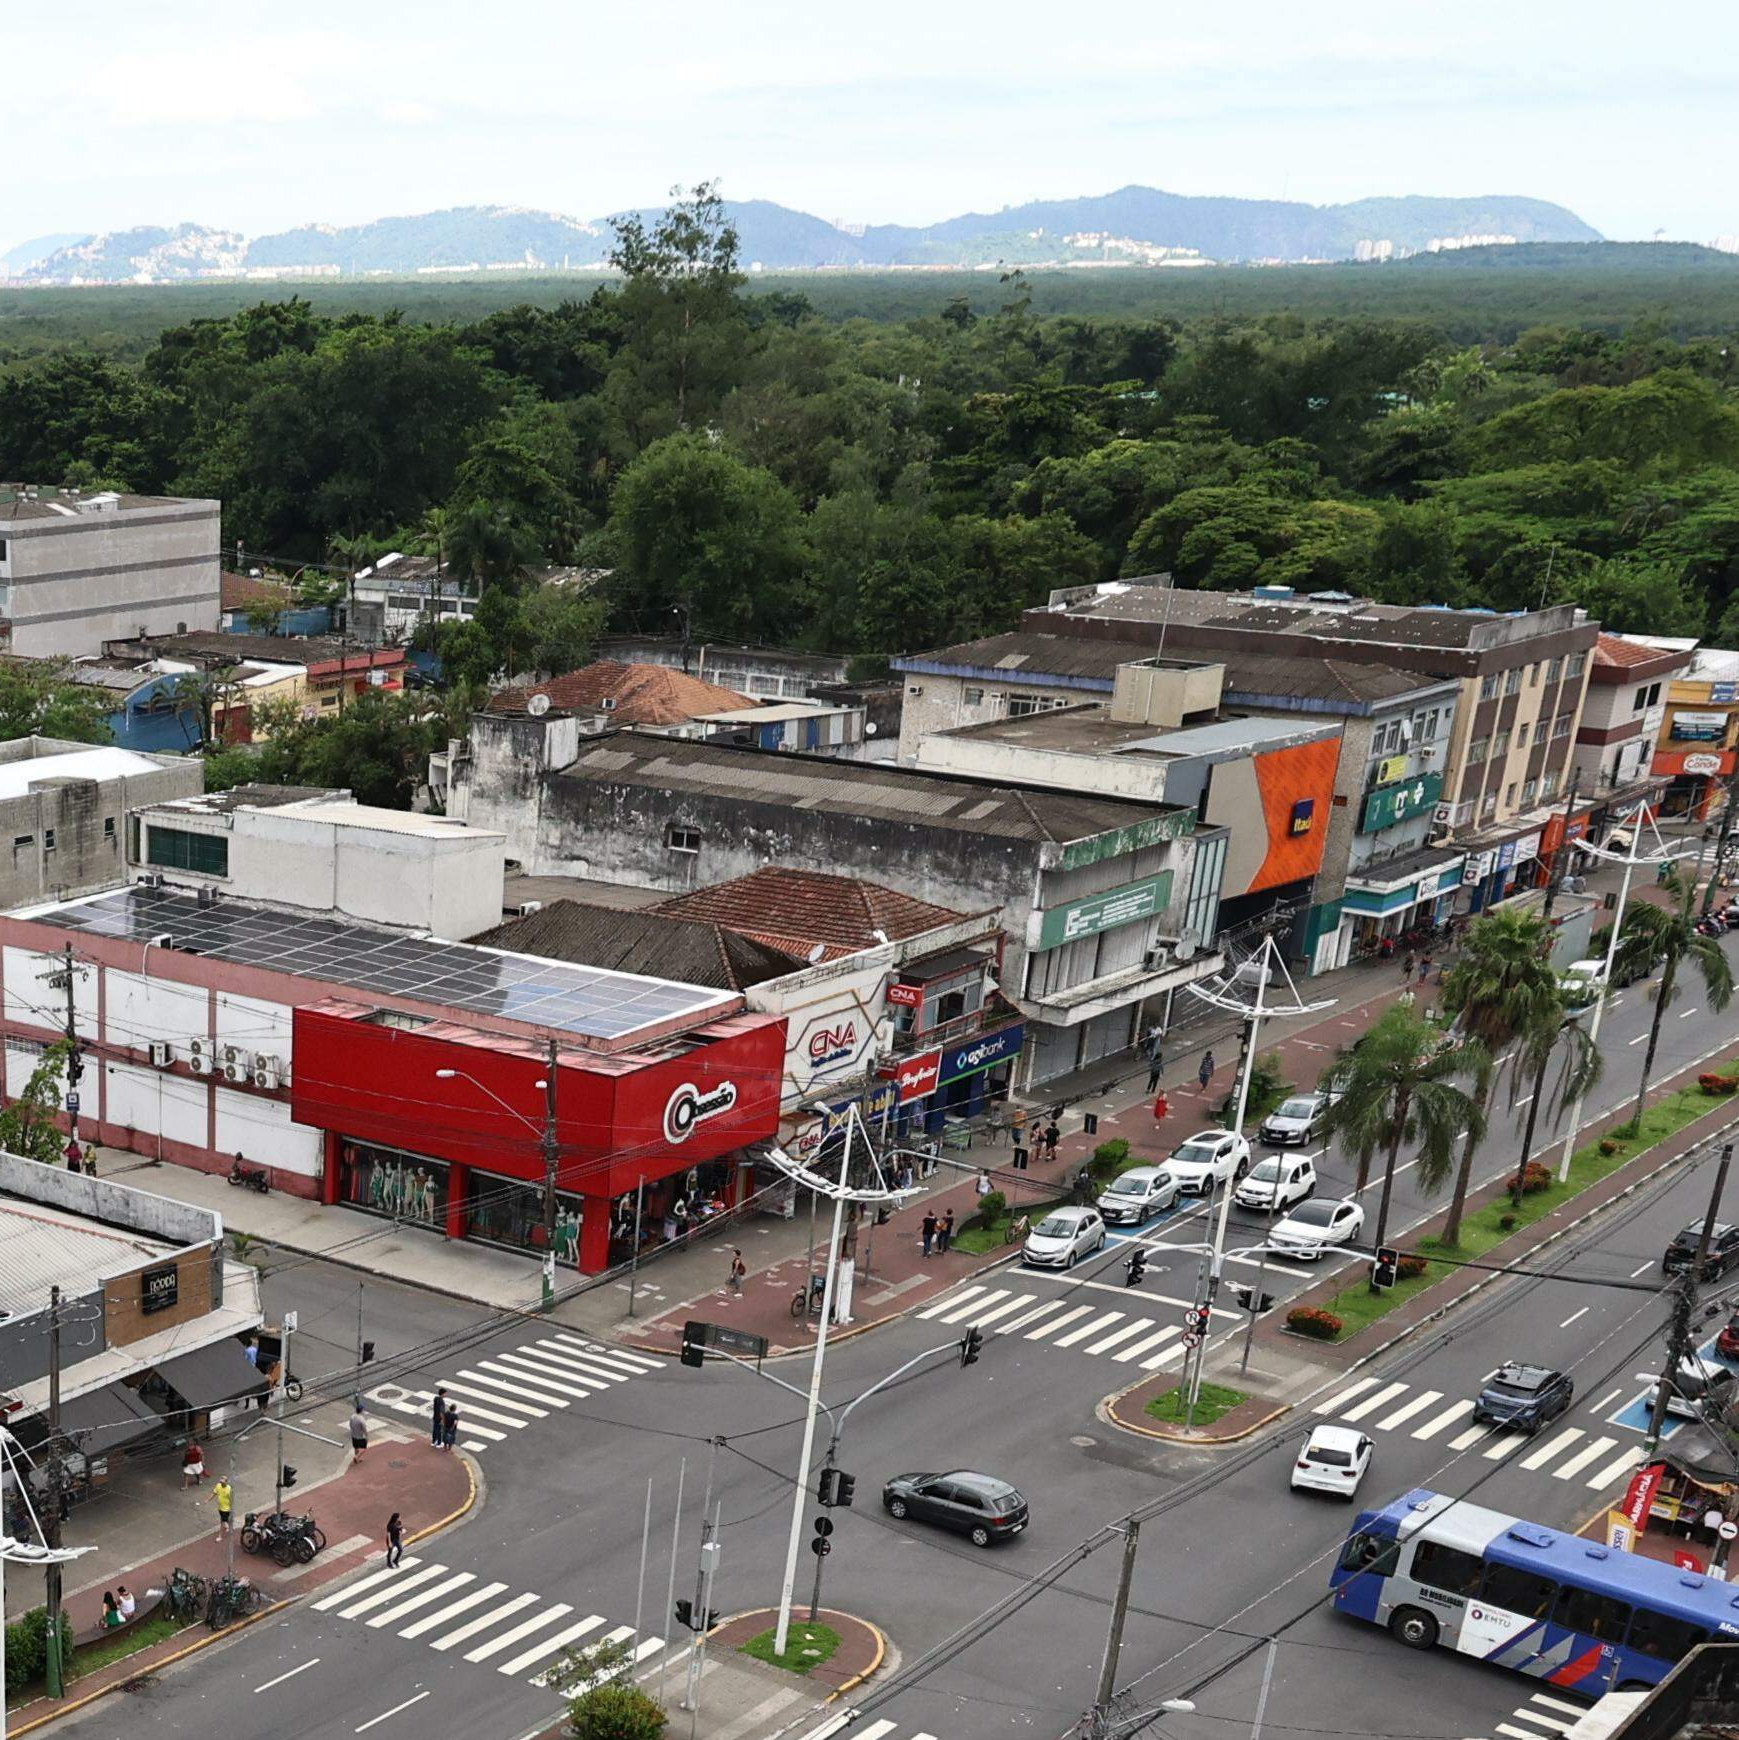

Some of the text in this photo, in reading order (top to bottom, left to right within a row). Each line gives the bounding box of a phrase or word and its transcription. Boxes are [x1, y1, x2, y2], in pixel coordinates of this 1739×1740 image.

[890, 988, 916, 1001] CNA
[809, 1021, 857, 1058] CNA
[967, 1037, 1006, 1065] agibank
[1630, 1474, 1654, 1524] ARMÁCIA
